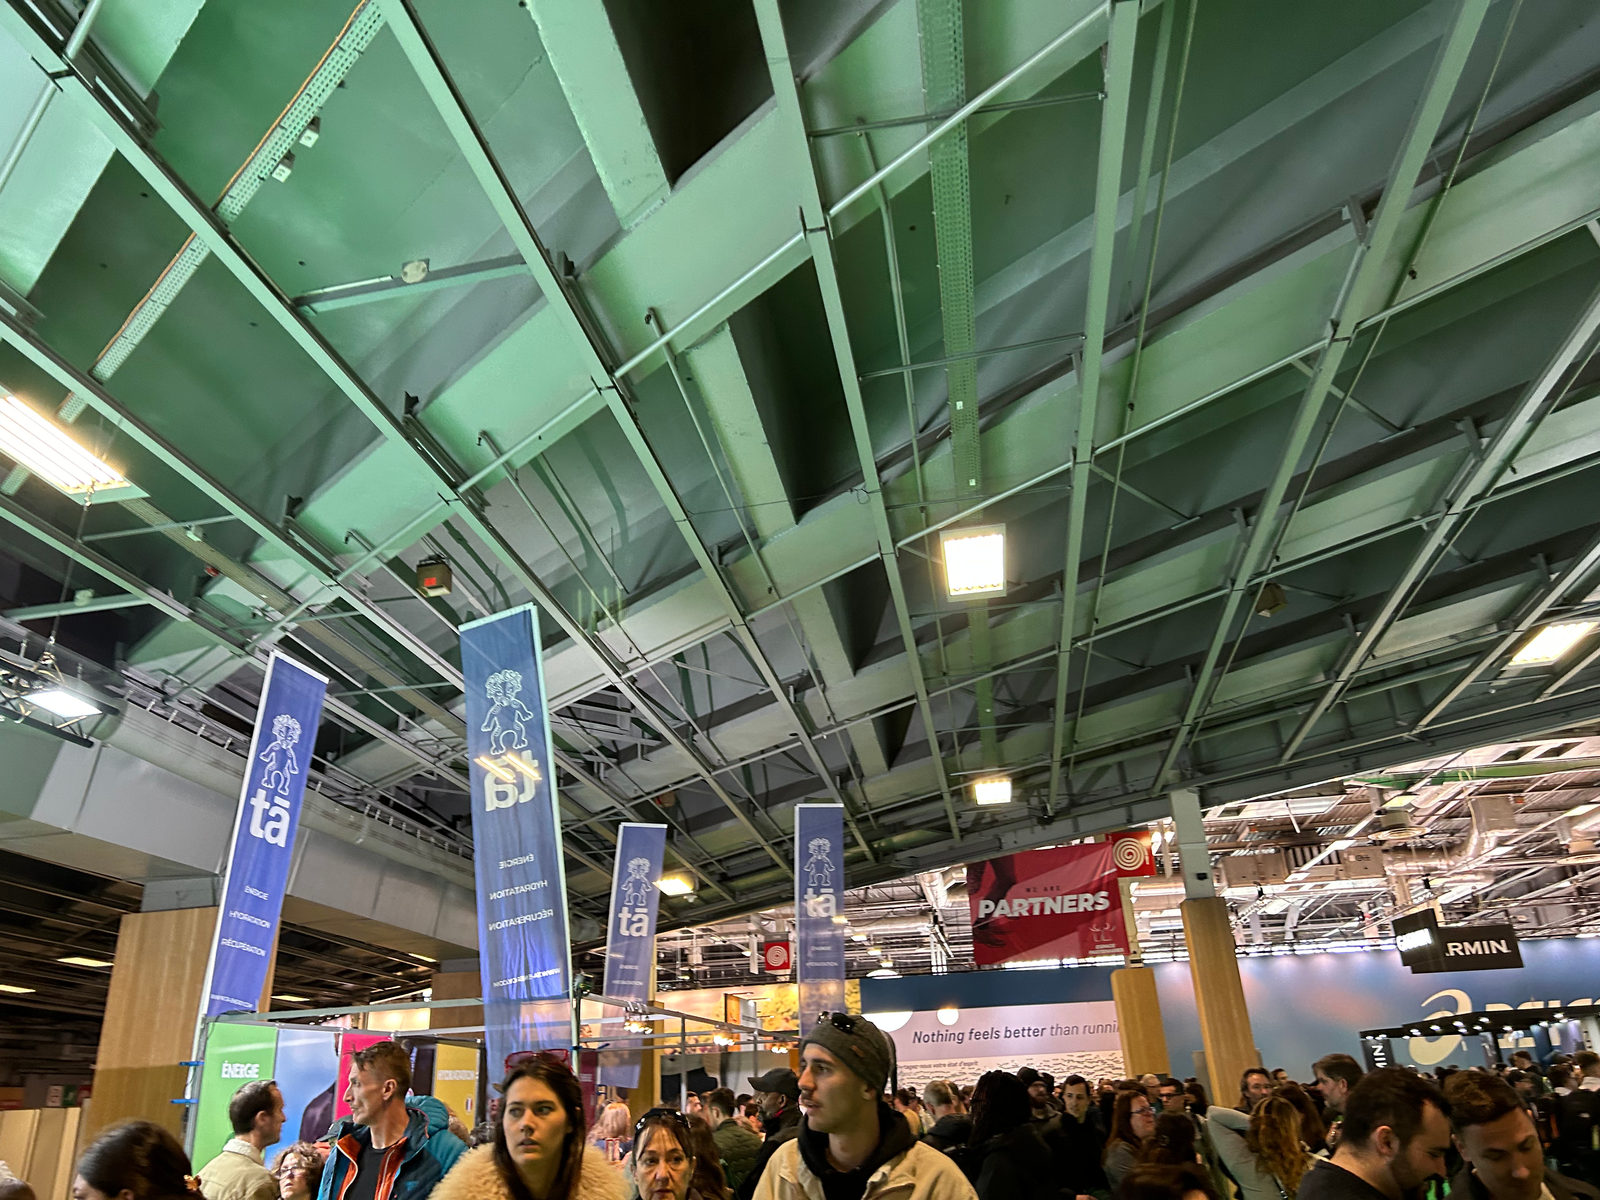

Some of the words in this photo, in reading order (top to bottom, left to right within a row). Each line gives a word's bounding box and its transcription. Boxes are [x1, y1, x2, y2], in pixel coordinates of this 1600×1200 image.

[250, 788, 290, 848] tā
[978, 891, 1110, 918] PARTNERS
[618, 906, 649, 937] tā
[912, 1029, 965, 1044] Nothing
[968, 1027, 1000, 1040] feels
[1004, 1026, 1046, 1038] better
[1050, 1023, 1079, 1036] than
